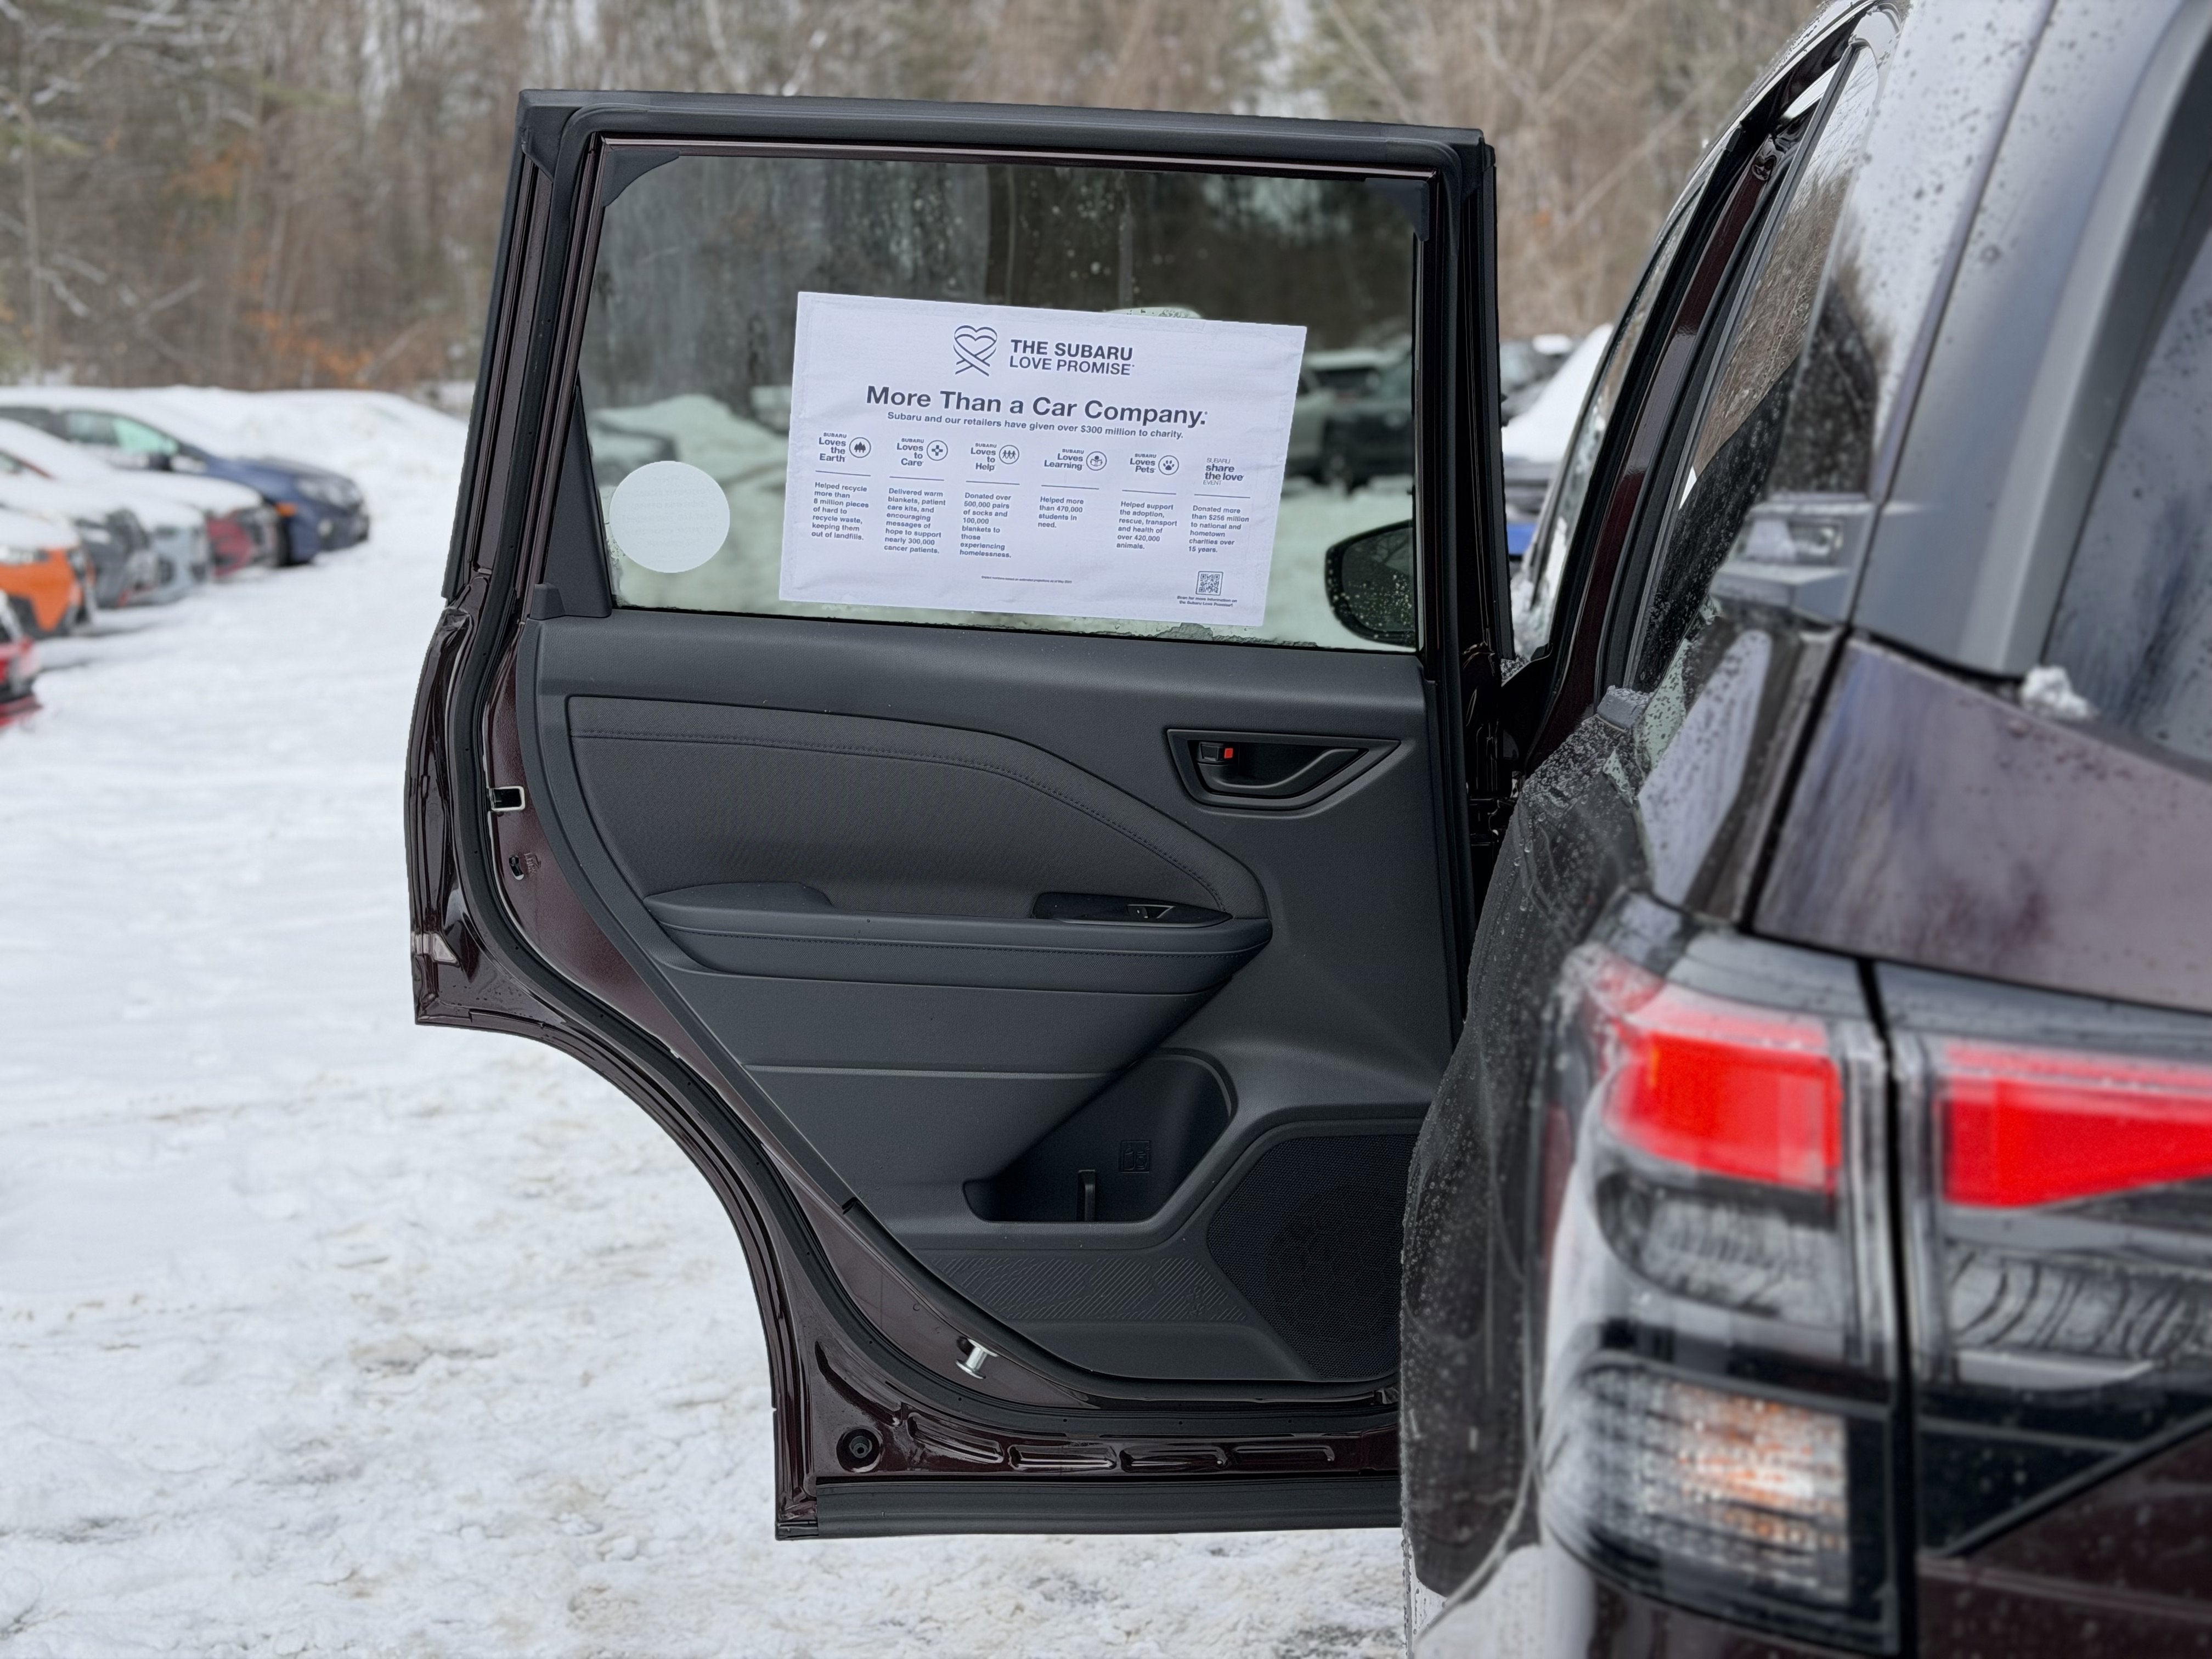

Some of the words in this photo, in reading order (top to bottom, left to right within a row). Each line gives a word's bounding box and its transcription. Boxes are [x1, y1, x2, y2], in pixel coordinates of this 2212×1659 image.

[1011, 339, 1048, 355] THE
[1054, 342, 1132, 360] SUBARU
[1009, 356, 1052, 370] LOVE
[1057, 359, 1131, 375] PROMISE
[867, 386, 931, 407] More
[940, 391, 1001, 413] Than
[1009, 400, 1024, 414] a
[1032, 397, 1077, 416] Car
[1085, 400, 1206, 428] Company.
[887, 411, 921, 421] Subaru
[963, 418, 1001, 427] retailers
[1005, 420, 1026, 428] have
[1029, 422, 1054, 431] given
[1080, 425, 1102, 434] $300
[1105, 427, 1136, 436] million
[1150, 430, 1183, 439] charity.
[819, 437, 846, 447] Loves
[831, 446, 845, 454] the
[896, 443, 923, 452] Loves
[970, 447, 996, 455] Loves
[819, 453, 846, 462] Earth
[1057, 453, 1083, 461] Loves
[901, 458, 924, 466] Care
[1044, 460, 1082, 471] Learning
[1130, 458, 1155, 466] Loves
[975, 462, 995, 472] Help
[1205, 463, 1234, 472] share
[1205, 471, 1221, 480] the
[1222, 472, 1244, 481] love
[815, 482, 839, 490] Helped
[888, 495, 919, 505] blankets,
[1040, 496, 1064, 504] Helped
[887, 512, 930, 522] encouraging
[812, 522, 840, 531] keeping
[960, 543, 1005, 551] experiencing
[960, 550, 1011, 558] homelessness.
